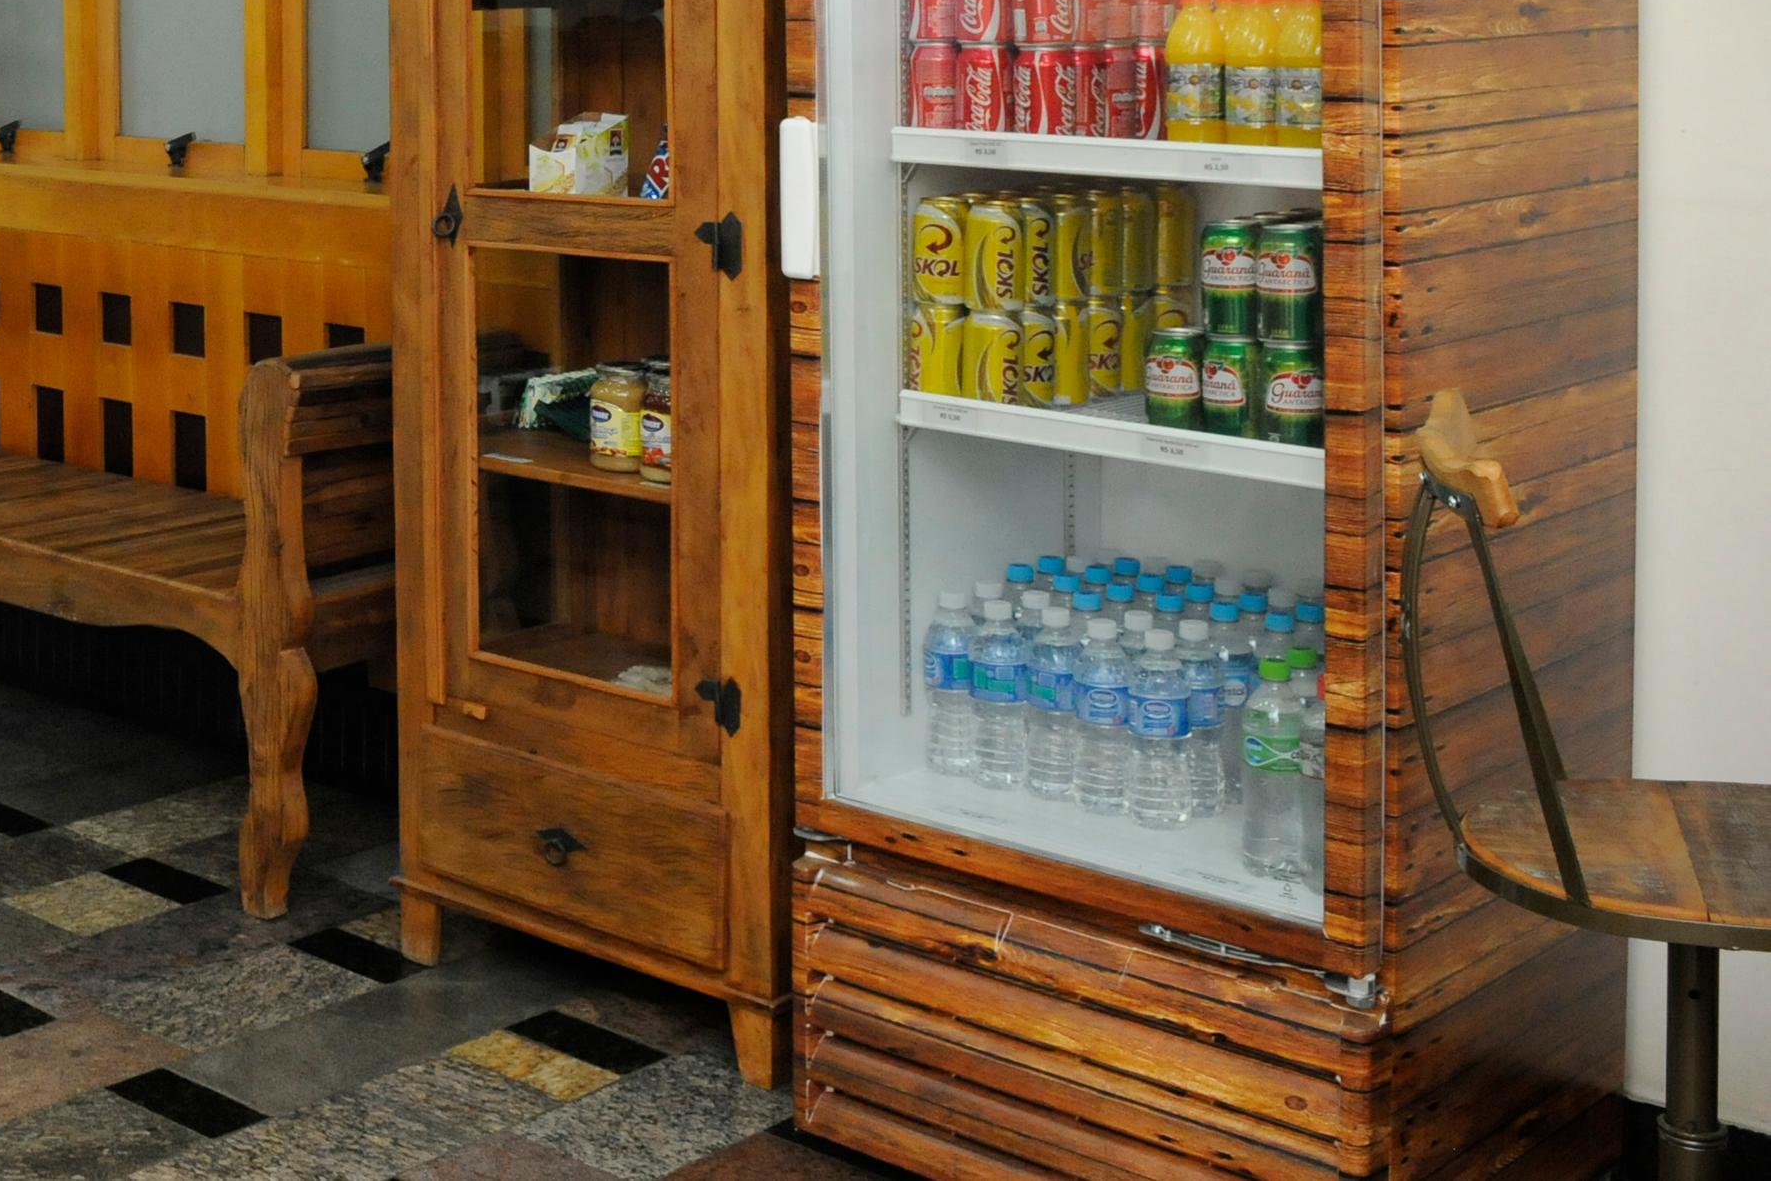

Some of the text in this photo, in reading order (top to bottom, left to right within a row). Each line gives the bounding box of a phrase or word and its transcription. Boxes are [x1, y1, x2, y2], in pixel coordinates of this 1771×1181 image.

[916, 258, 960, 277] SKOL
[996, 249, 1014, 299] SKOL
[1032, 243, 1049, 296] SKOL
